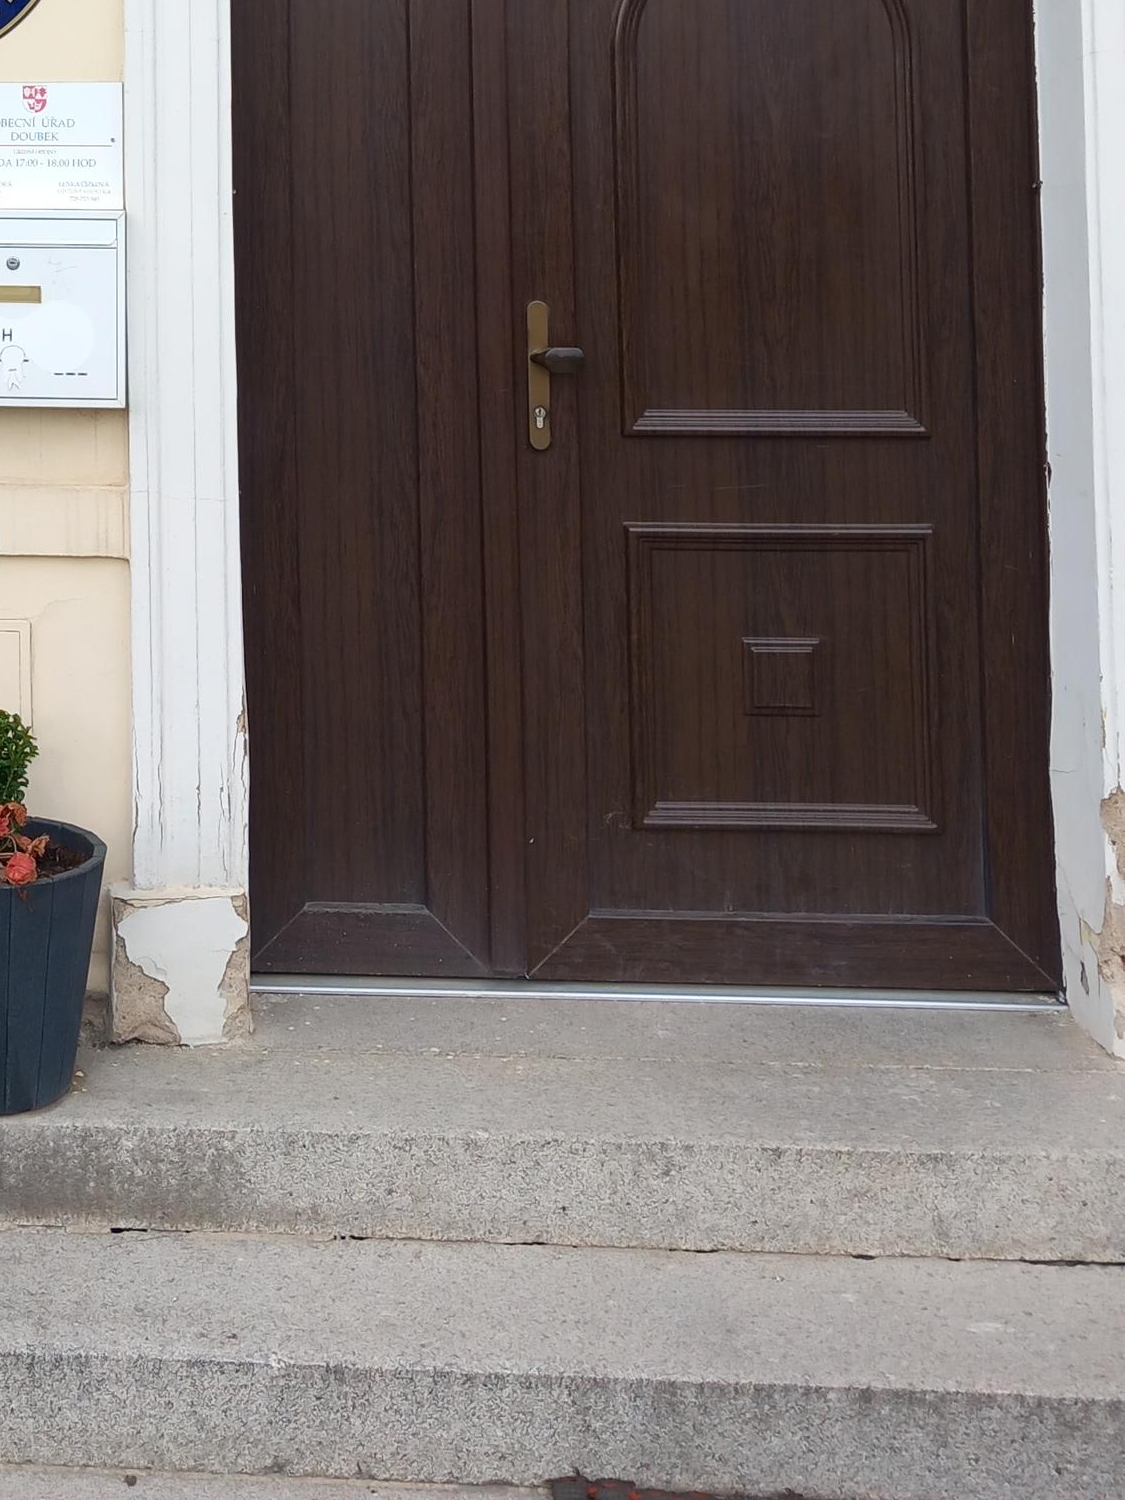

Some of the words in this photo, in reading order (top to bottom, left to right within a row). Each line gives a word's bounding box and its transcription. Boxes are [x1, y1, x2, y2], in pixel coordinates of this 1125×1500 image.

[41, 116, 75, 128] ÚŘAD
[10, 132, 59, 141] DOUBEK
[72, 158, 97, 168] HOD
